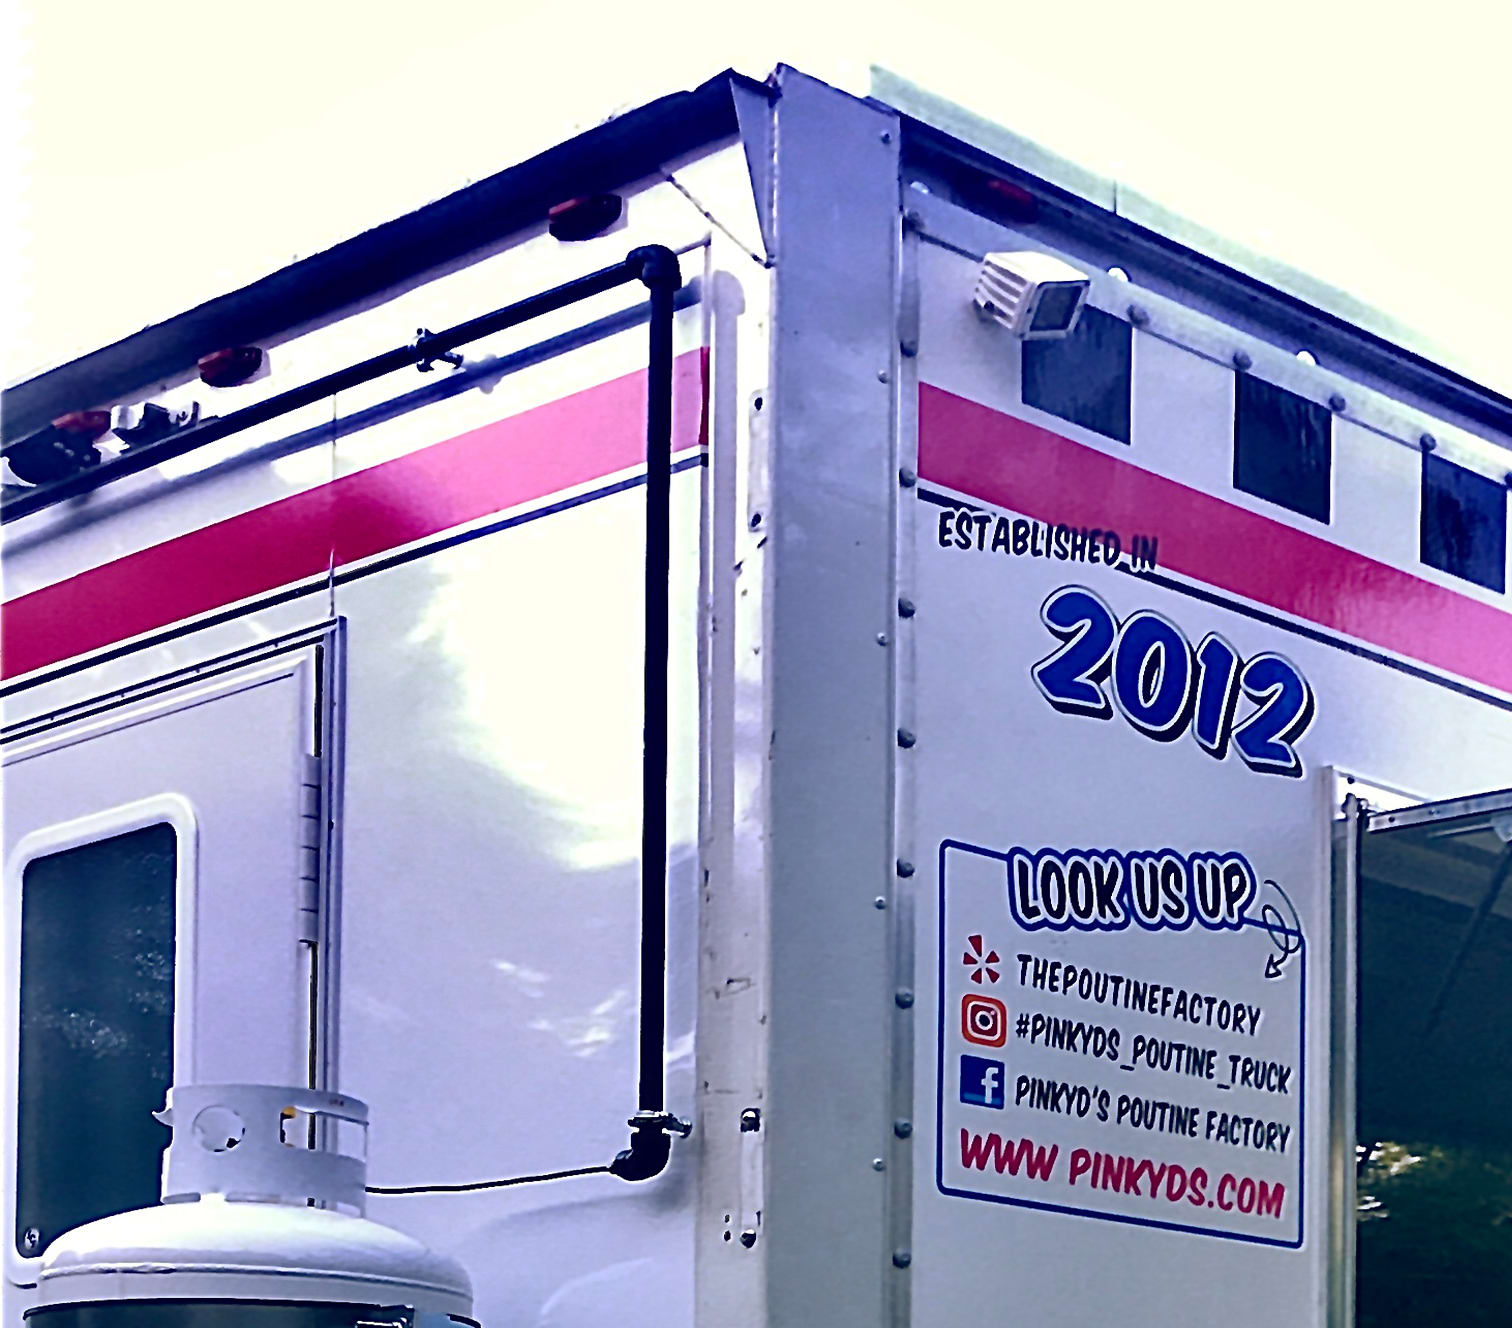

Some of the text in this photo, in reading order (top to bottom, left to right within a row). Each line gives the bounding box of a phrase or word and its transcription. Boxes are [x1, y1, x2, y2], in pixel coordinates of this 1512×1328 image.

[938, 510, 1159, 571] ESTABLISHED IN
[1030, 584, 1316, 779] 2012
[1017, 858, 1248, 920] LOOK US UP
[1016, 953, 1261, 1036] THEPOUTINEFACTORY
[1015, 1013, 1292, 1094] #PINKYDS_POUTINE_TRUCK
[1015, 1075, 1291, 1154] PINKYD'S POUTINE FACTORY
[960, 1127, 1286, 1219] WWW PINKYDS.COM
